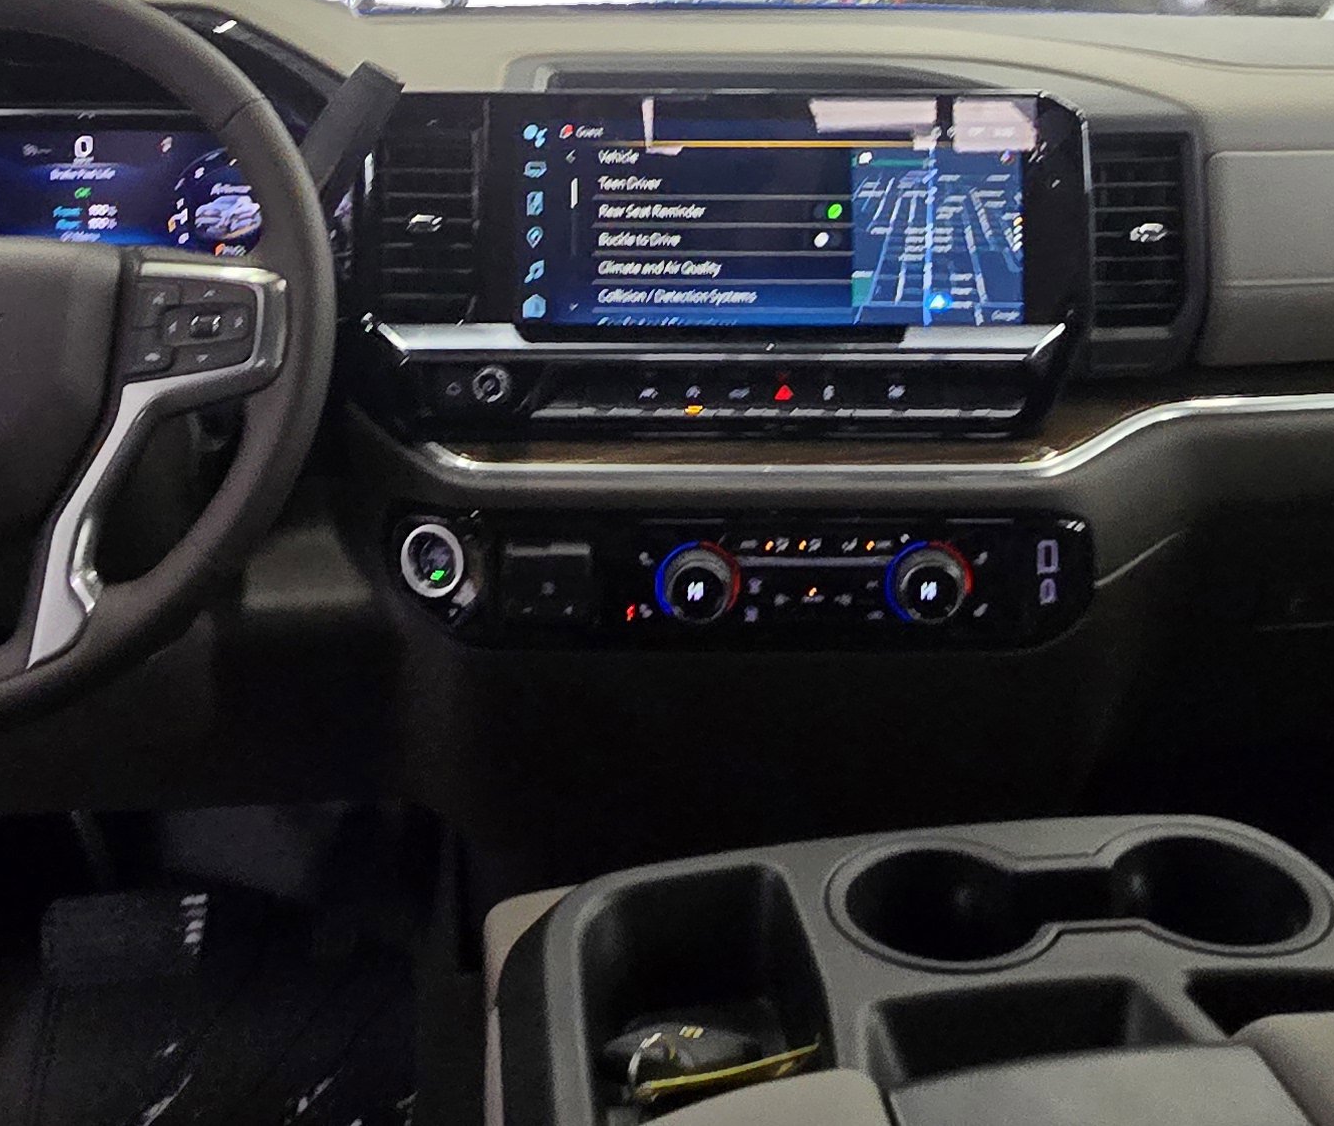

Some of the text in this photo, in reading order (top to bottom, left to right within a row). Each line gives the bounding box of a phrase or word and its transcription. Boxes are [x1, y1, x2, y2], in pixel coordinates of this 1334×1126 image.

[73, 134, 94, 158] 0
[598, 146, 640, 164] Vehicle
[597, 175, 663, 190] Teen Driver
[598, 202, 707, 219] Rear Seat Reminder
[598, 232, 682, 247] Buckle to Drive
[597, 259, 722, 278] Climate and Air Quality
[597, 288, 647, 303] Collision
[654, 288, 709, 303] Detection
[708, 288, 757, 305] Systems
